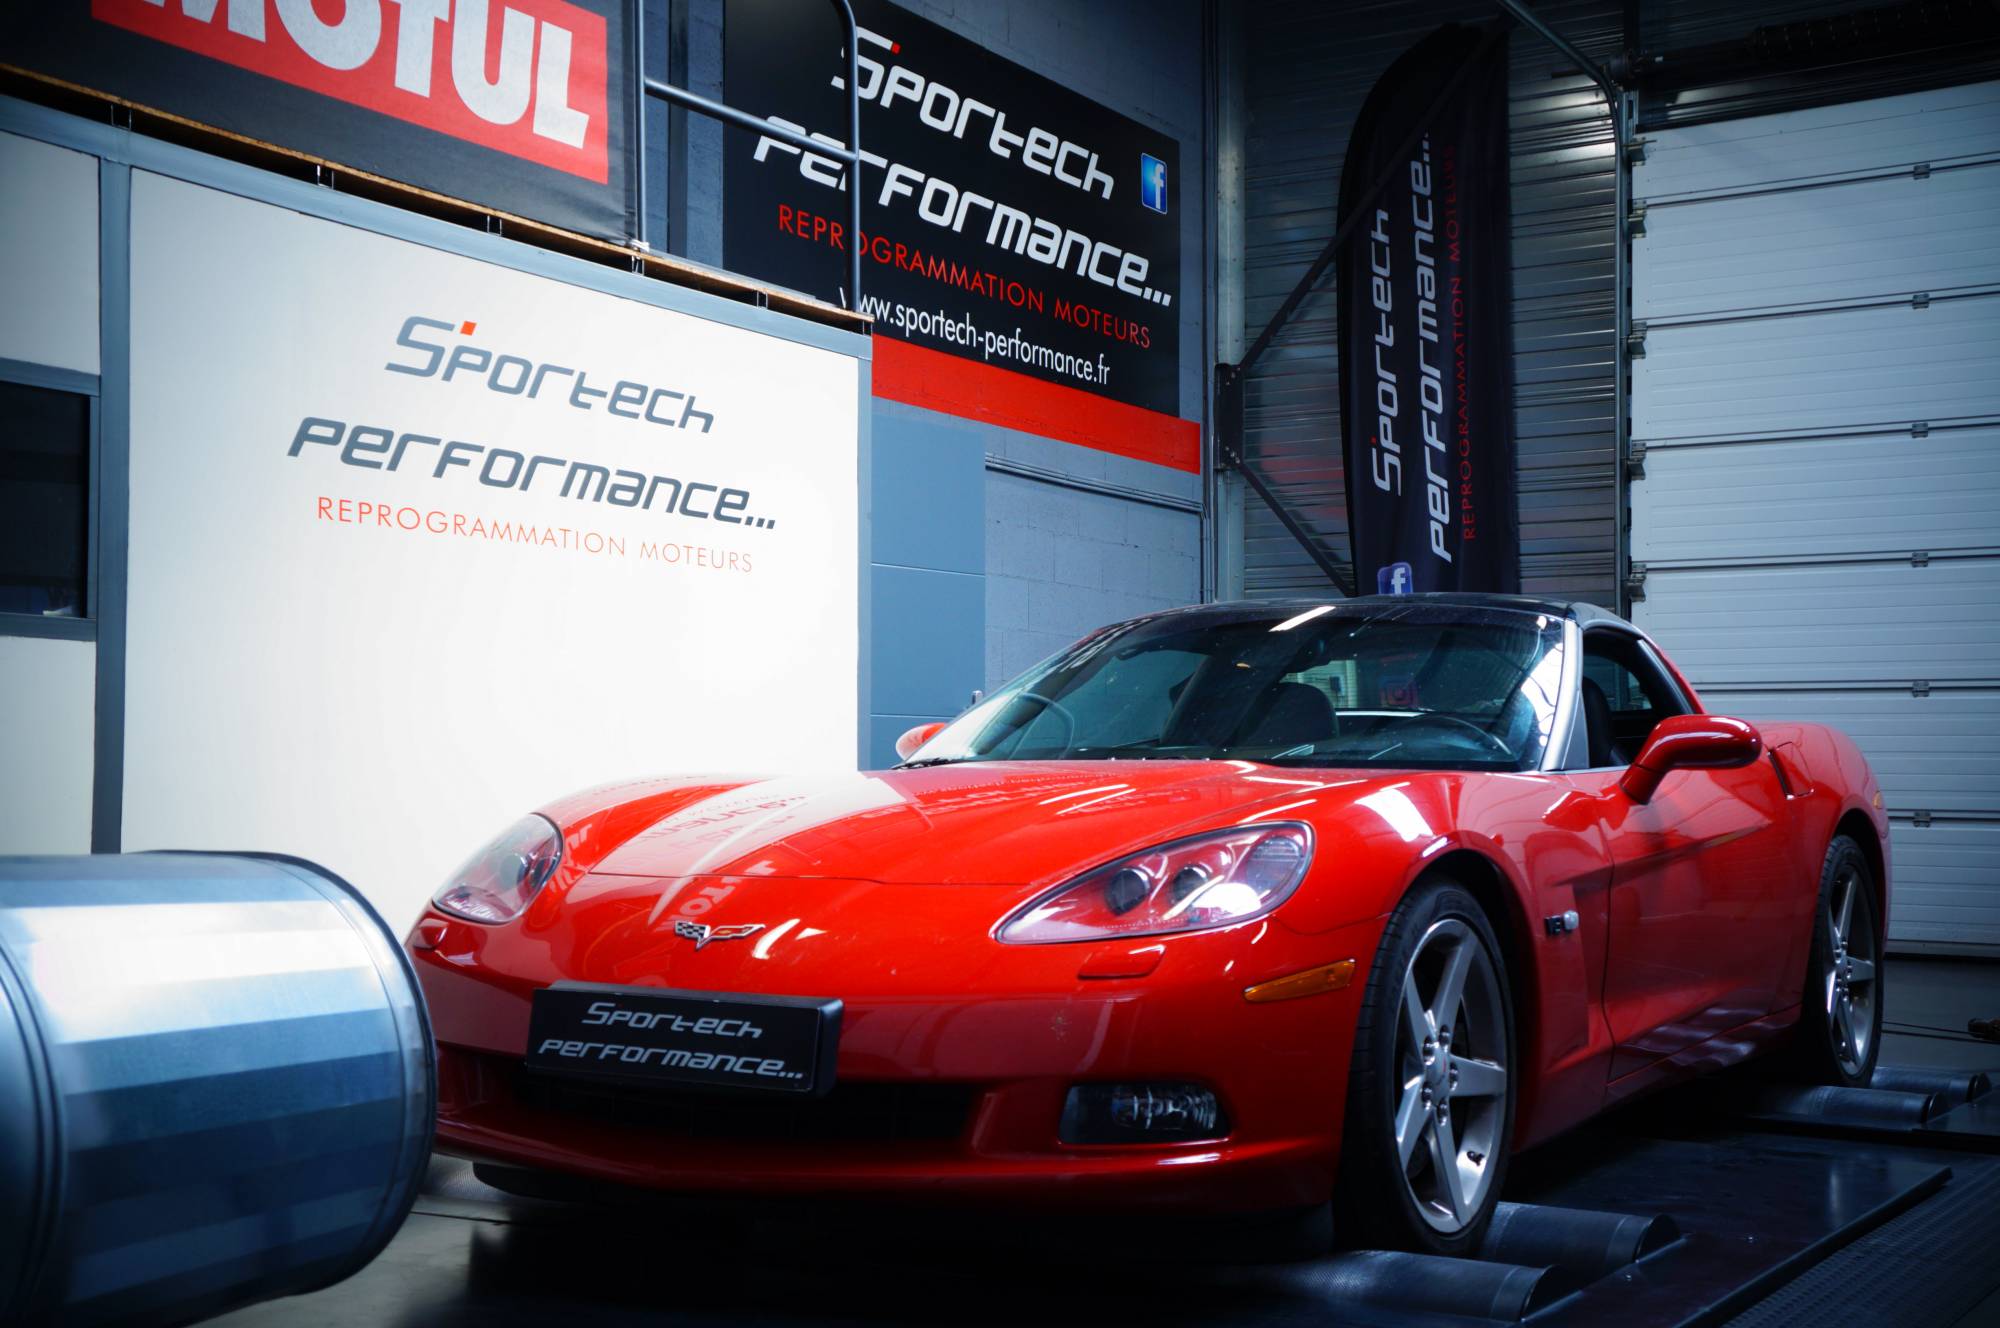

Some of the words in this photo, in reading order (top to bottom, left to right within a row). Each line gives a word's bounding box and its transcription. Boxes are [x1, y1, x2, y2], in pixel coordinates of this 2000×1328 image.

[1445, 144, 1460, 262] MOTEURS
[839, 287, 1110, 385] ww.sportech-performance.fr
[1054, 297, 1151, 349] MOTEURS
[1451, 276, 1475, 540] REPROGRAMMATION
[317, 496, 626, 557] REPROGRAMMATION
[639, 541, 753, 573] MOTEURS
